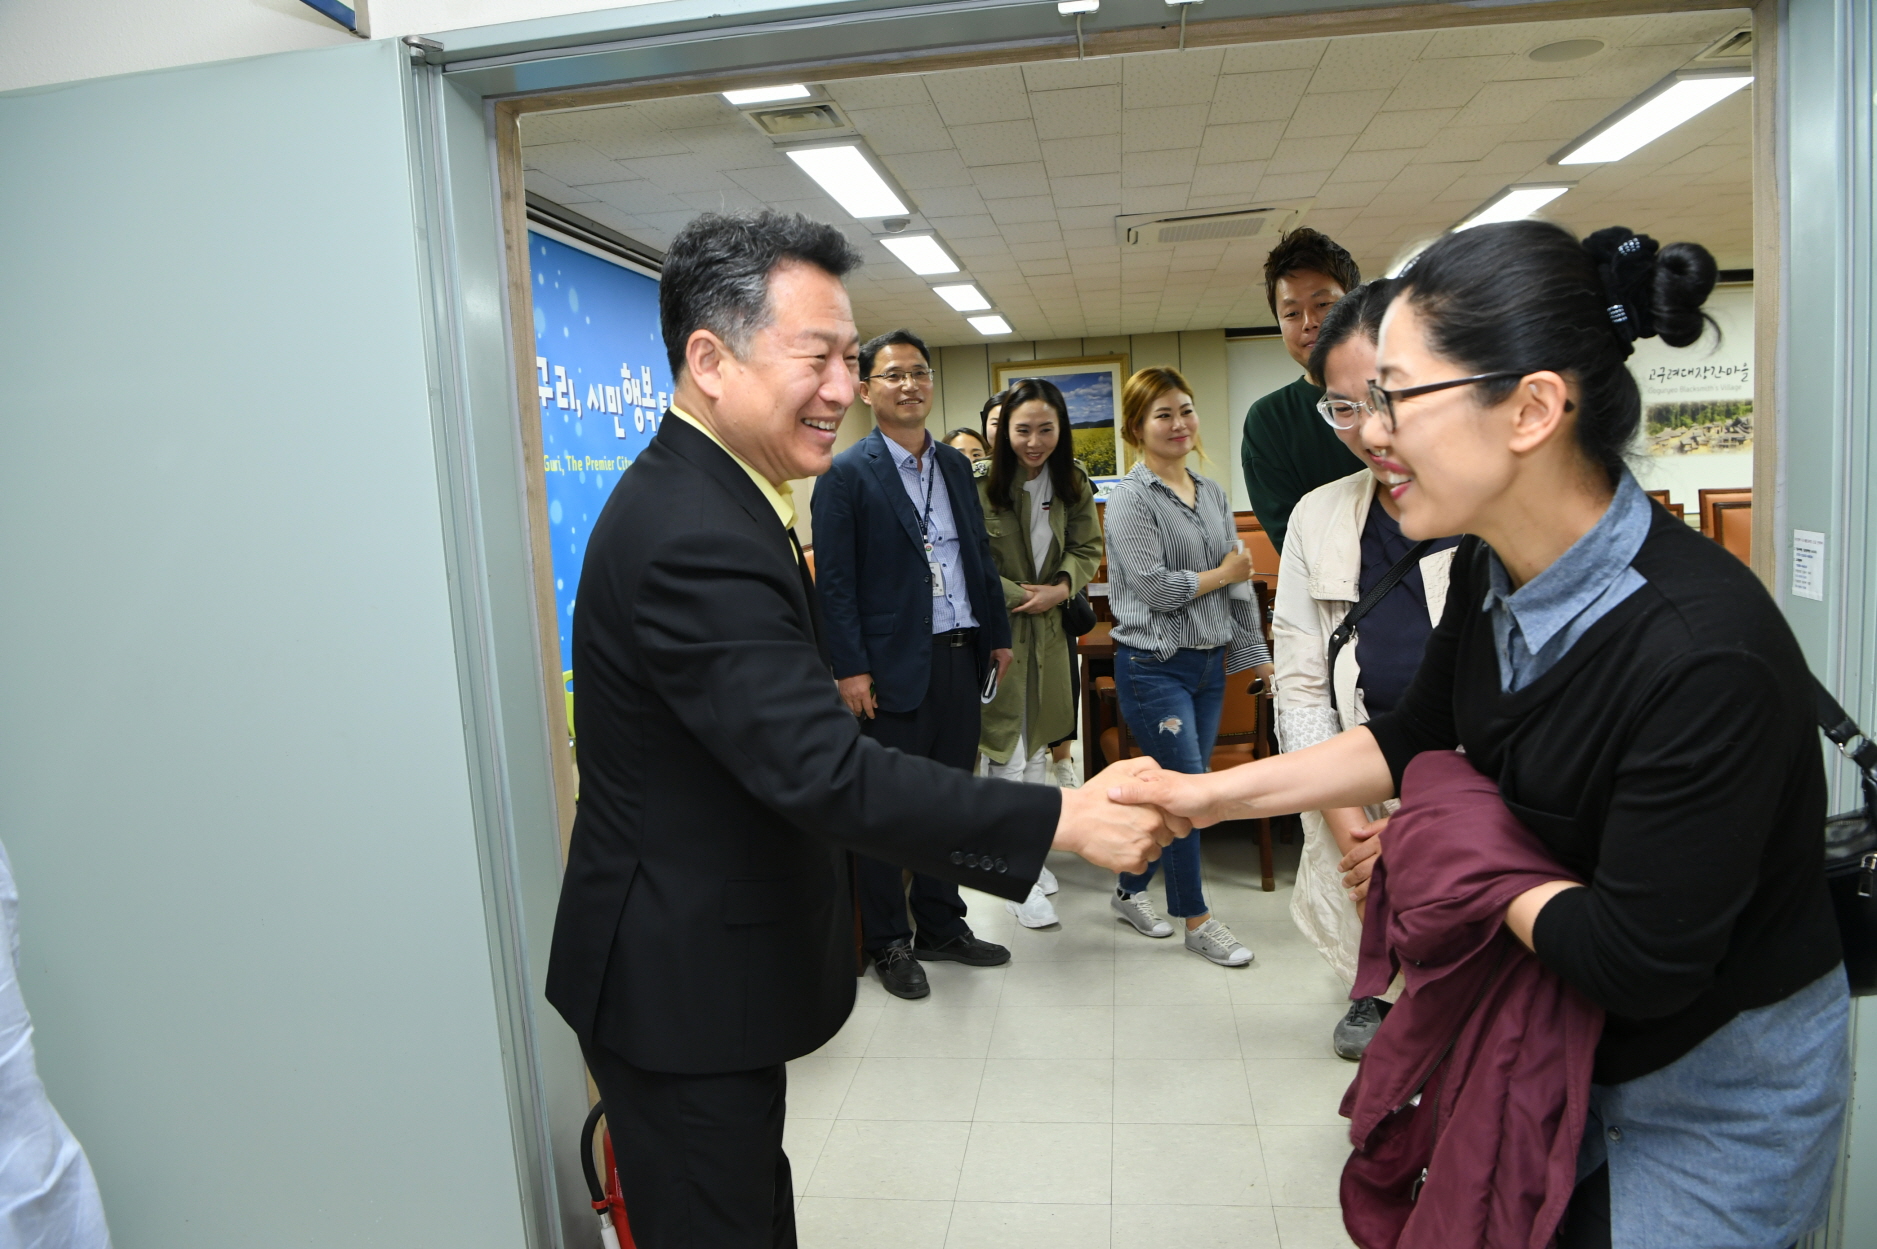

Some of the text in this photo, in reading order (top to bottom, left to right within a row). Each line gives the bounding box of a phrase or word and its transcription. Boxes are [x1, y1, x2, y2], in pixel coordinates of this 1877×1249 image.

[1720, 383, 1742, 392] Village
[543, 455, 565, 476] Guri,
[565, 455, 583, 472] The
[586, 455, 615, 471] Premier
